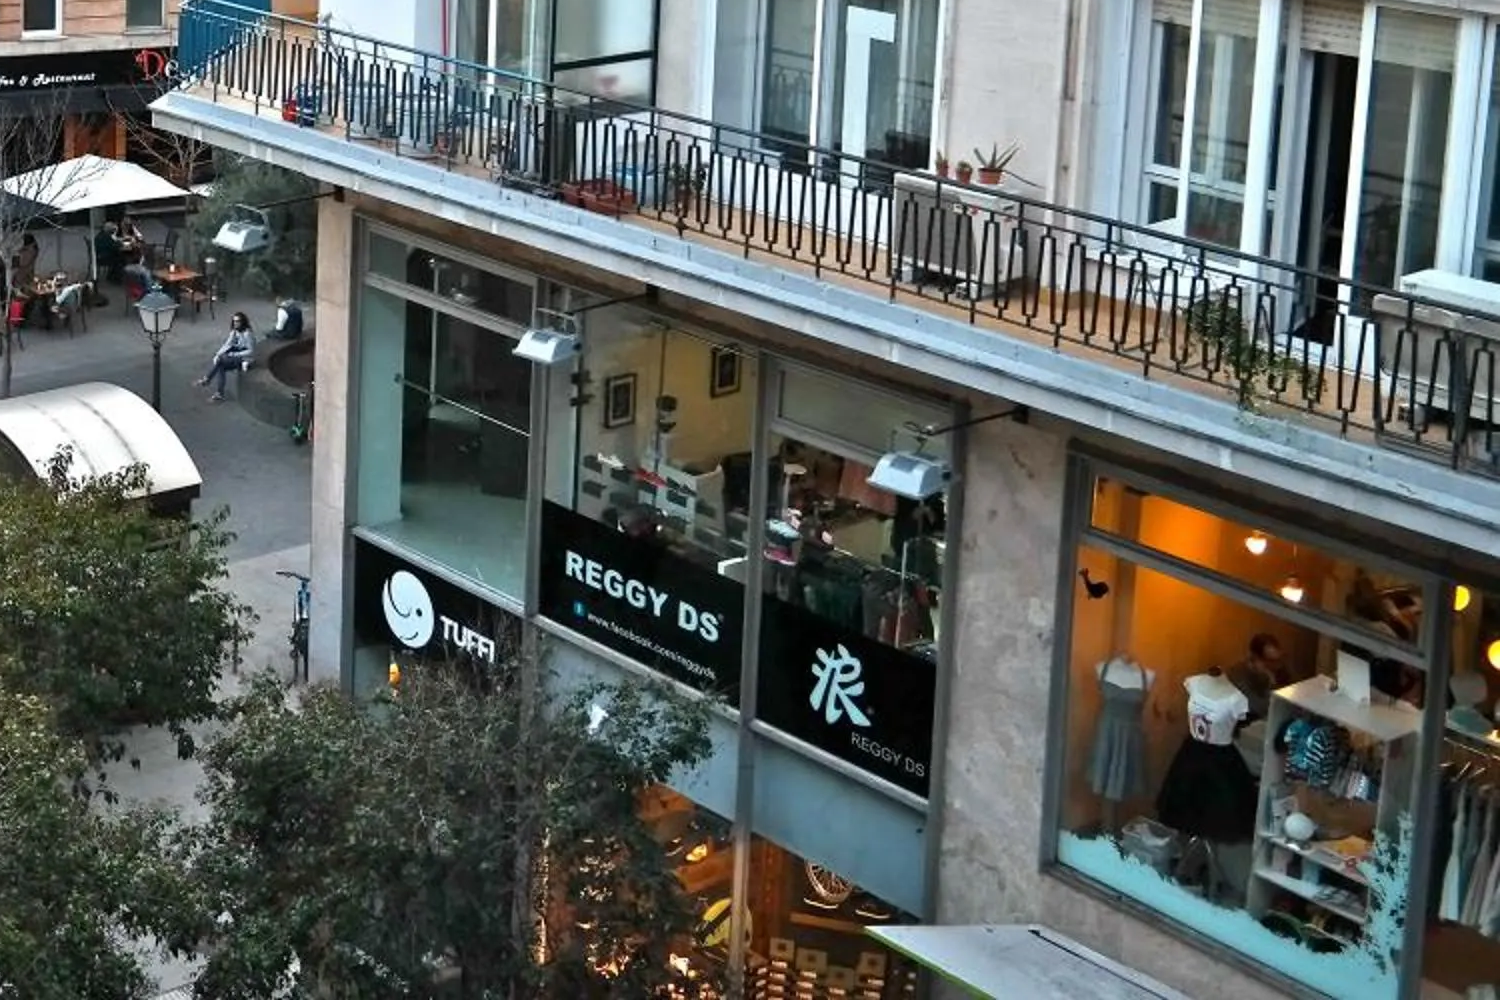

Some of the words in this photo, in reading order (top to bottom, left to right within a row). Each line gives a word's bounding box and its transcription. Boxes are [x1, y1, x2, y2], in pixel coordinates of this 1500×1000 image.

[565, 550, 669, 617] REGGY
[677, 600, 720, 643] DS
[851, 731, 902, 766] REGGY
[904, 757, 926, 777] DS
